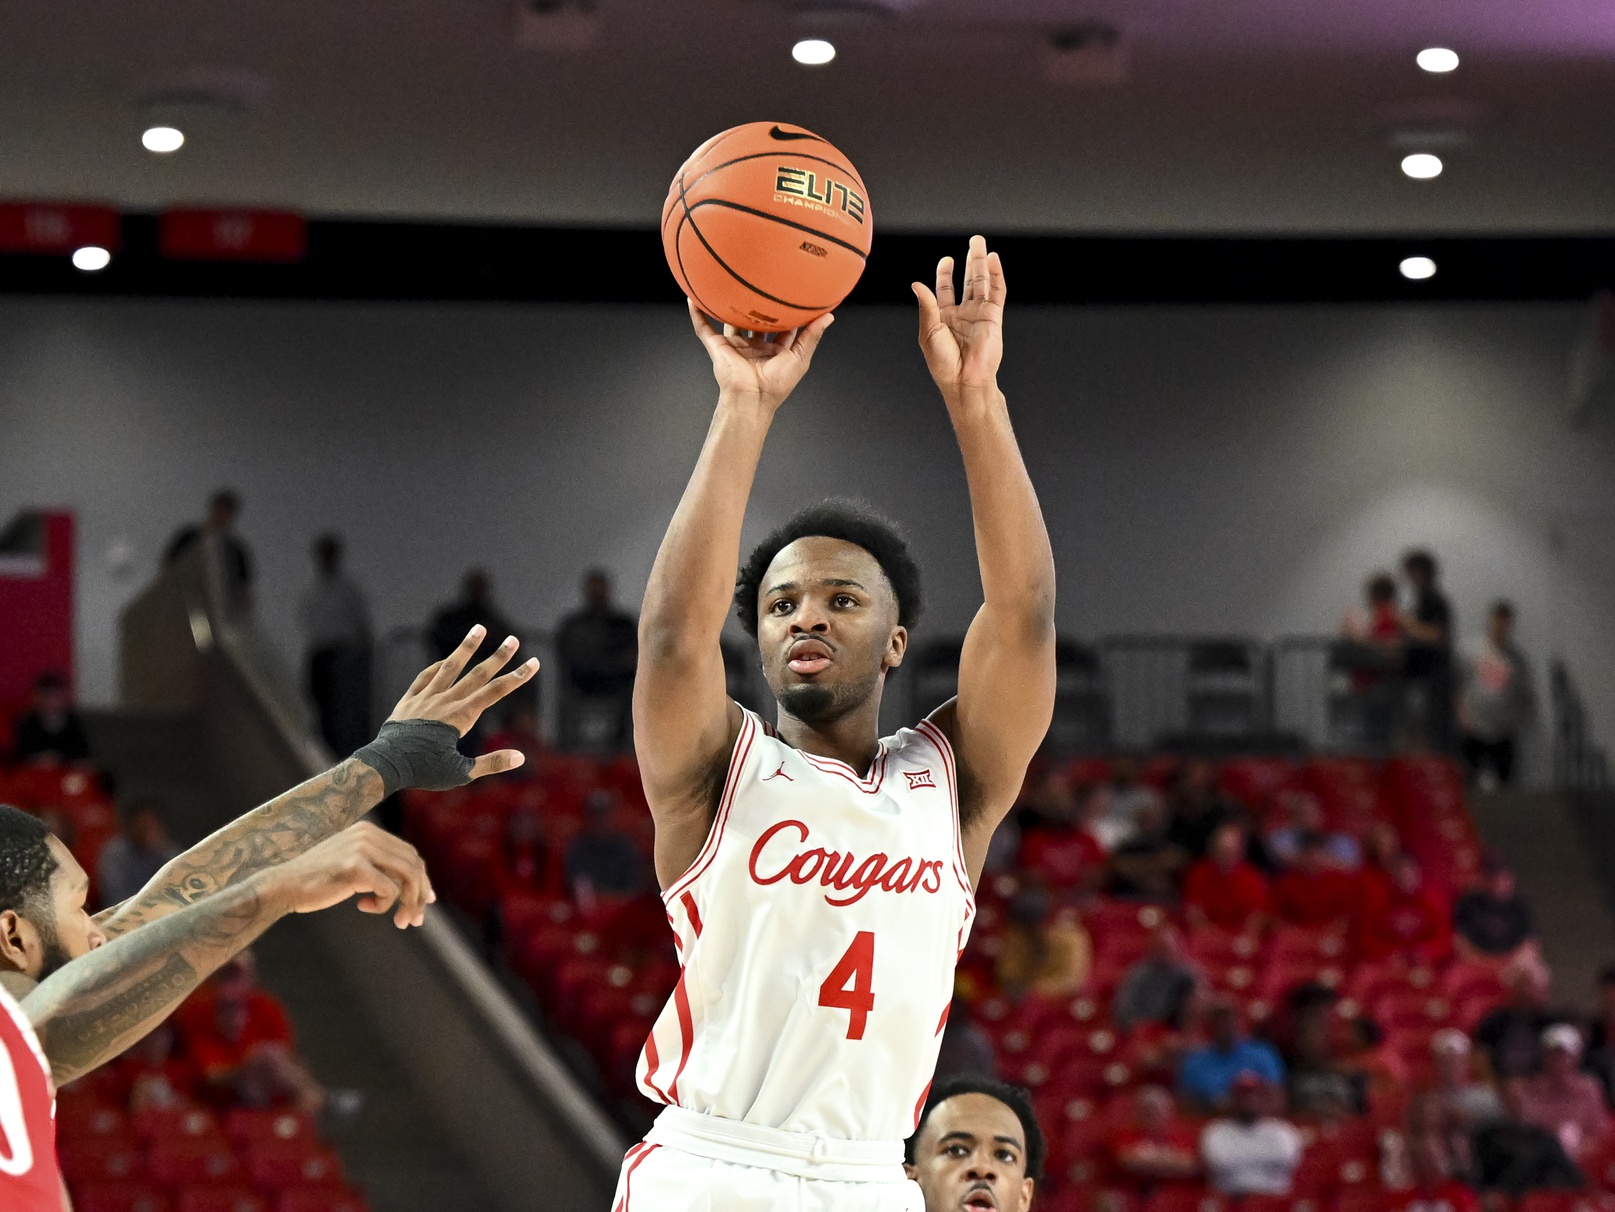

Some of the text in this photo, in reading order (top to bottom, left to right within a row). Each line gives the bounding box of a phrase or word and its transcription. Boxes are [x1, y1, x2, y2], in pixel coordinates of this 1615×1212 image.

[775, 166, 865, 225] ELITE
[749, 819, 943, 907] Cougars
[818, 930, 875, 1040] 4
